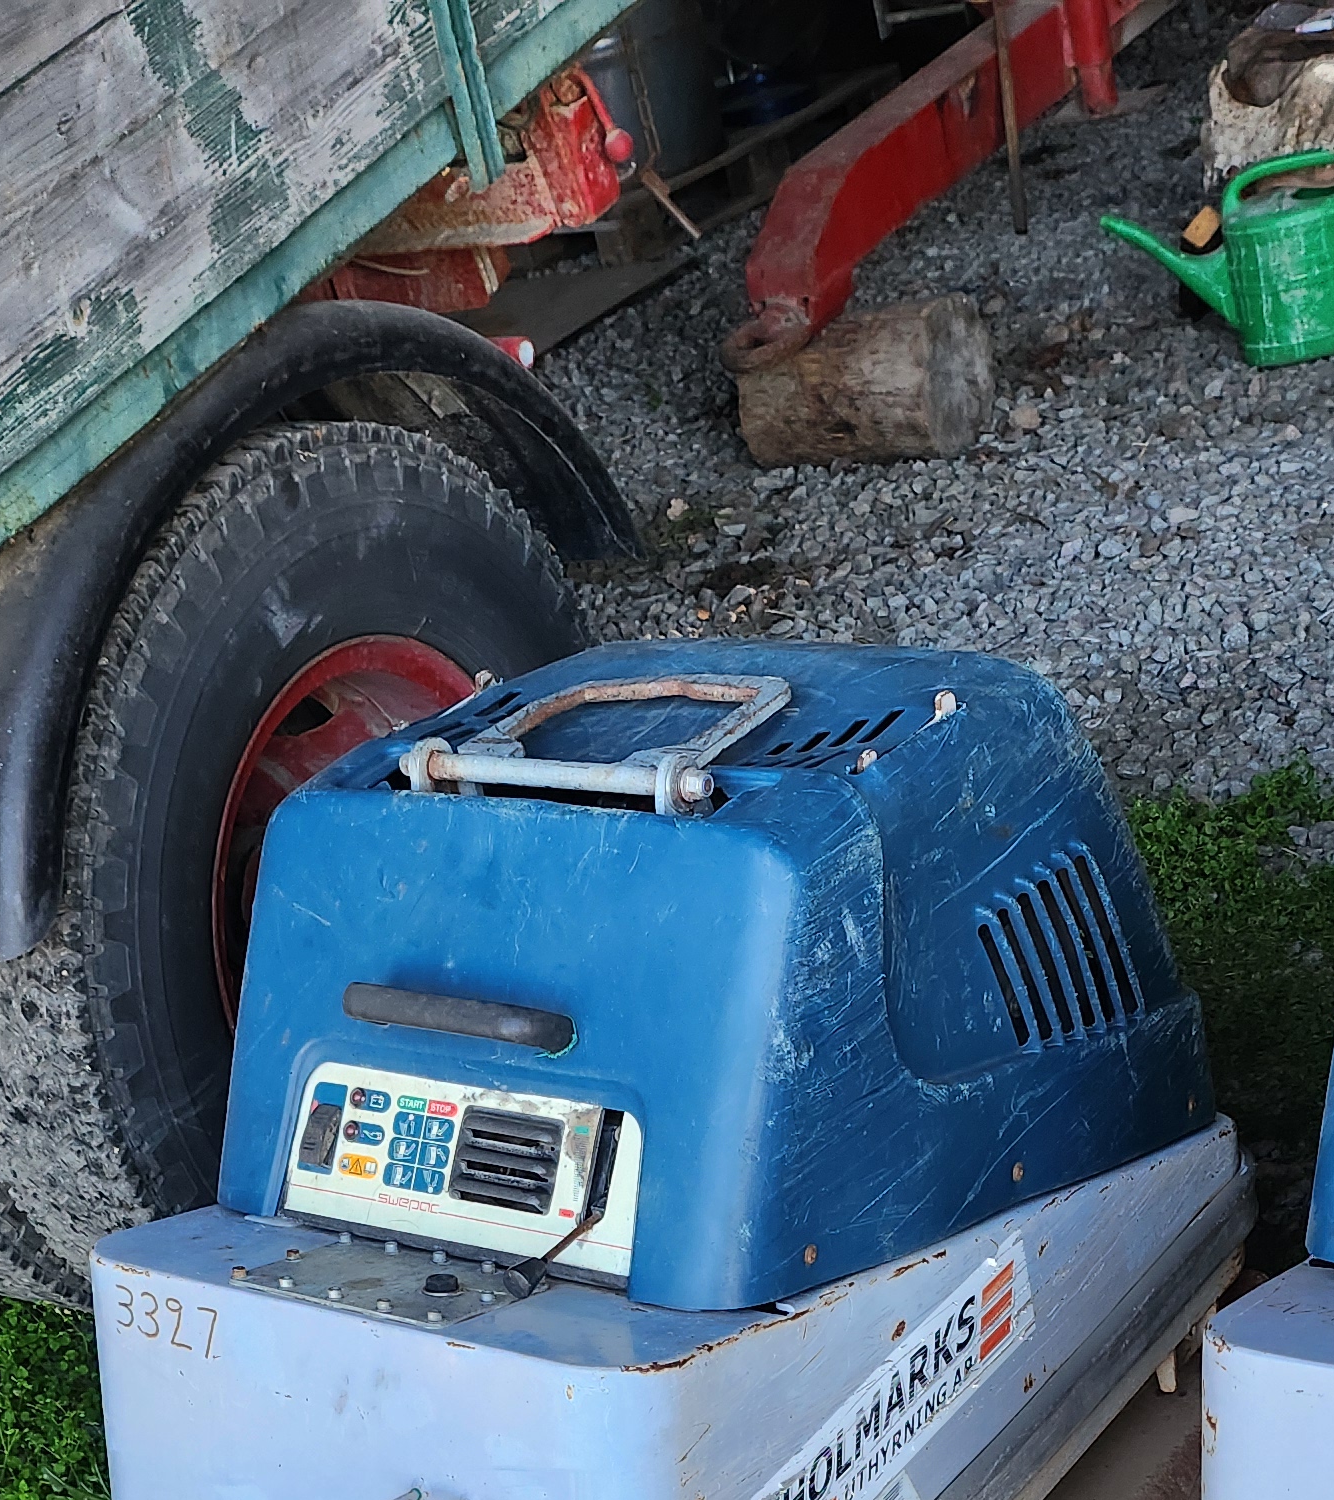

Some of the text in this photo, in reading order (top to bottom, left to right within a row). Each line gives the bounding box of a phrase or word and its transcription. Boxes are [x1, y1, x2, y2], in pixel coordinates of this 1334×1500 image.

[399, 1098, 452, 1114] START STOP
[377, 1193, 440, 1214] swepac
[115, 1284, 218, 1359] 3327
